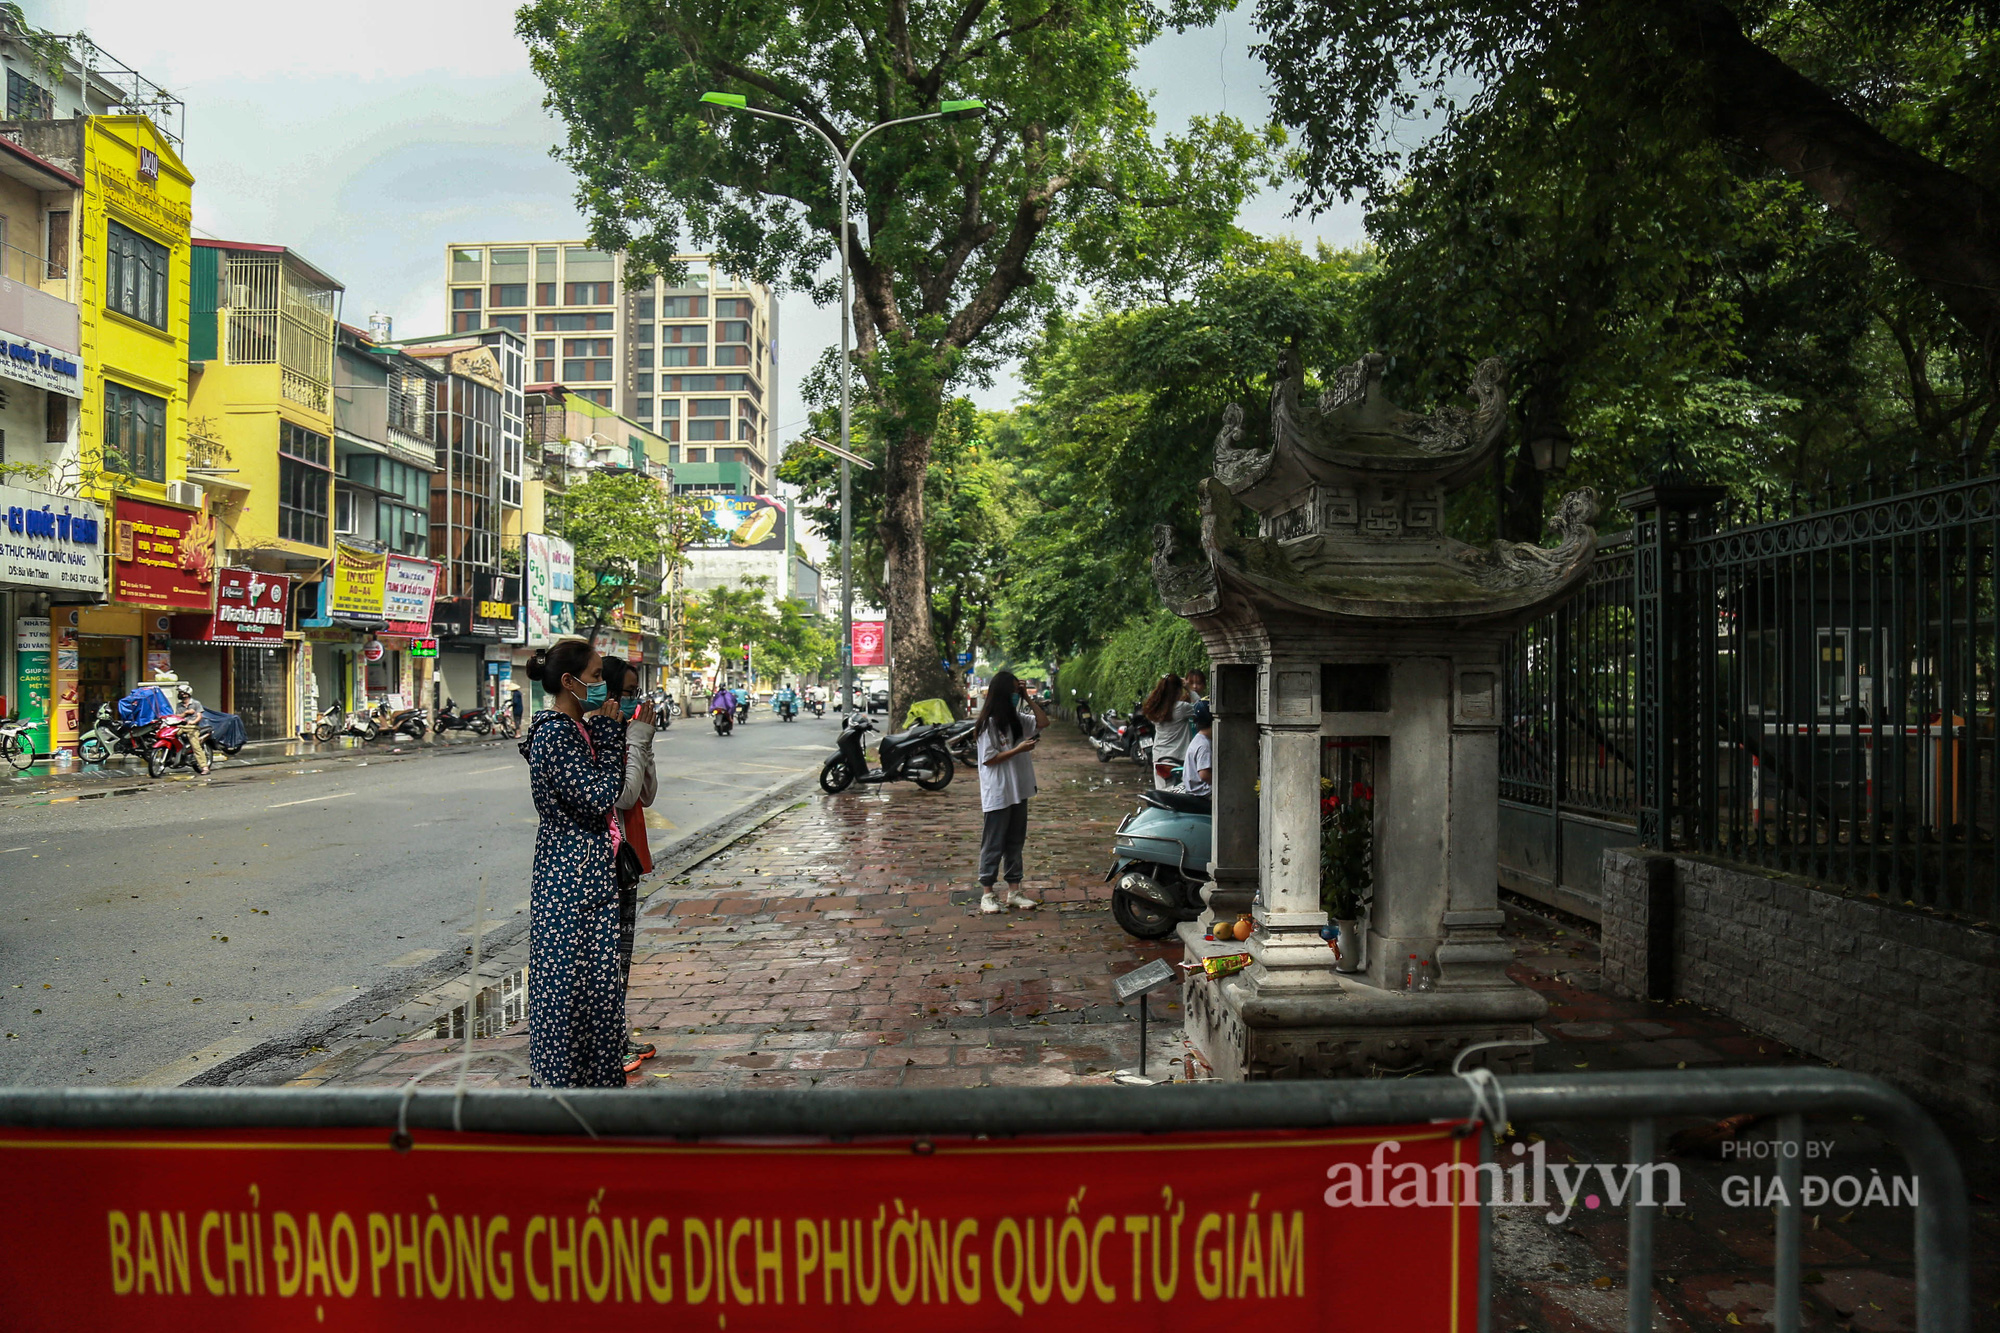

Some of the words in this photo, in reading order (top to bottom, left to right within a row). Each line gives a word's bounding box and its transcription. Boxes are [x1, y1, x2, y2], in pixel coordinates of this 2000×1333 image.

[26, 504, 55, 540] QUỐC
[56, 505, 72, 541] TỬ
[72, 514, 98, 545] GIÁM
[5, 544, 25, 560] THỰC
[26, 544, 47, 561] PHẨM
[48, 548, 66, 564] CHỨC
[67, 551, 86, 566] NĂNG
[108, 1210, 192, 1295] BAN
[199, 1183, 265, 1296] CHỈ
[273, 1212, 360, 1323] ĐẠO
[368, 1193, 514, 1300] PHÒNG
[524, 1187, 673, 1303] CHỐNG
[683, 1216, 784, 1330] DỊCH
[795, 1197, 982, 1304] PHƯỜNG
[993, 1185, 1117, 1317] QUỐC
[1124, 1184, 1186, 1301] TỬ
[1194, 1191, 1305, 1299] GIÁM
